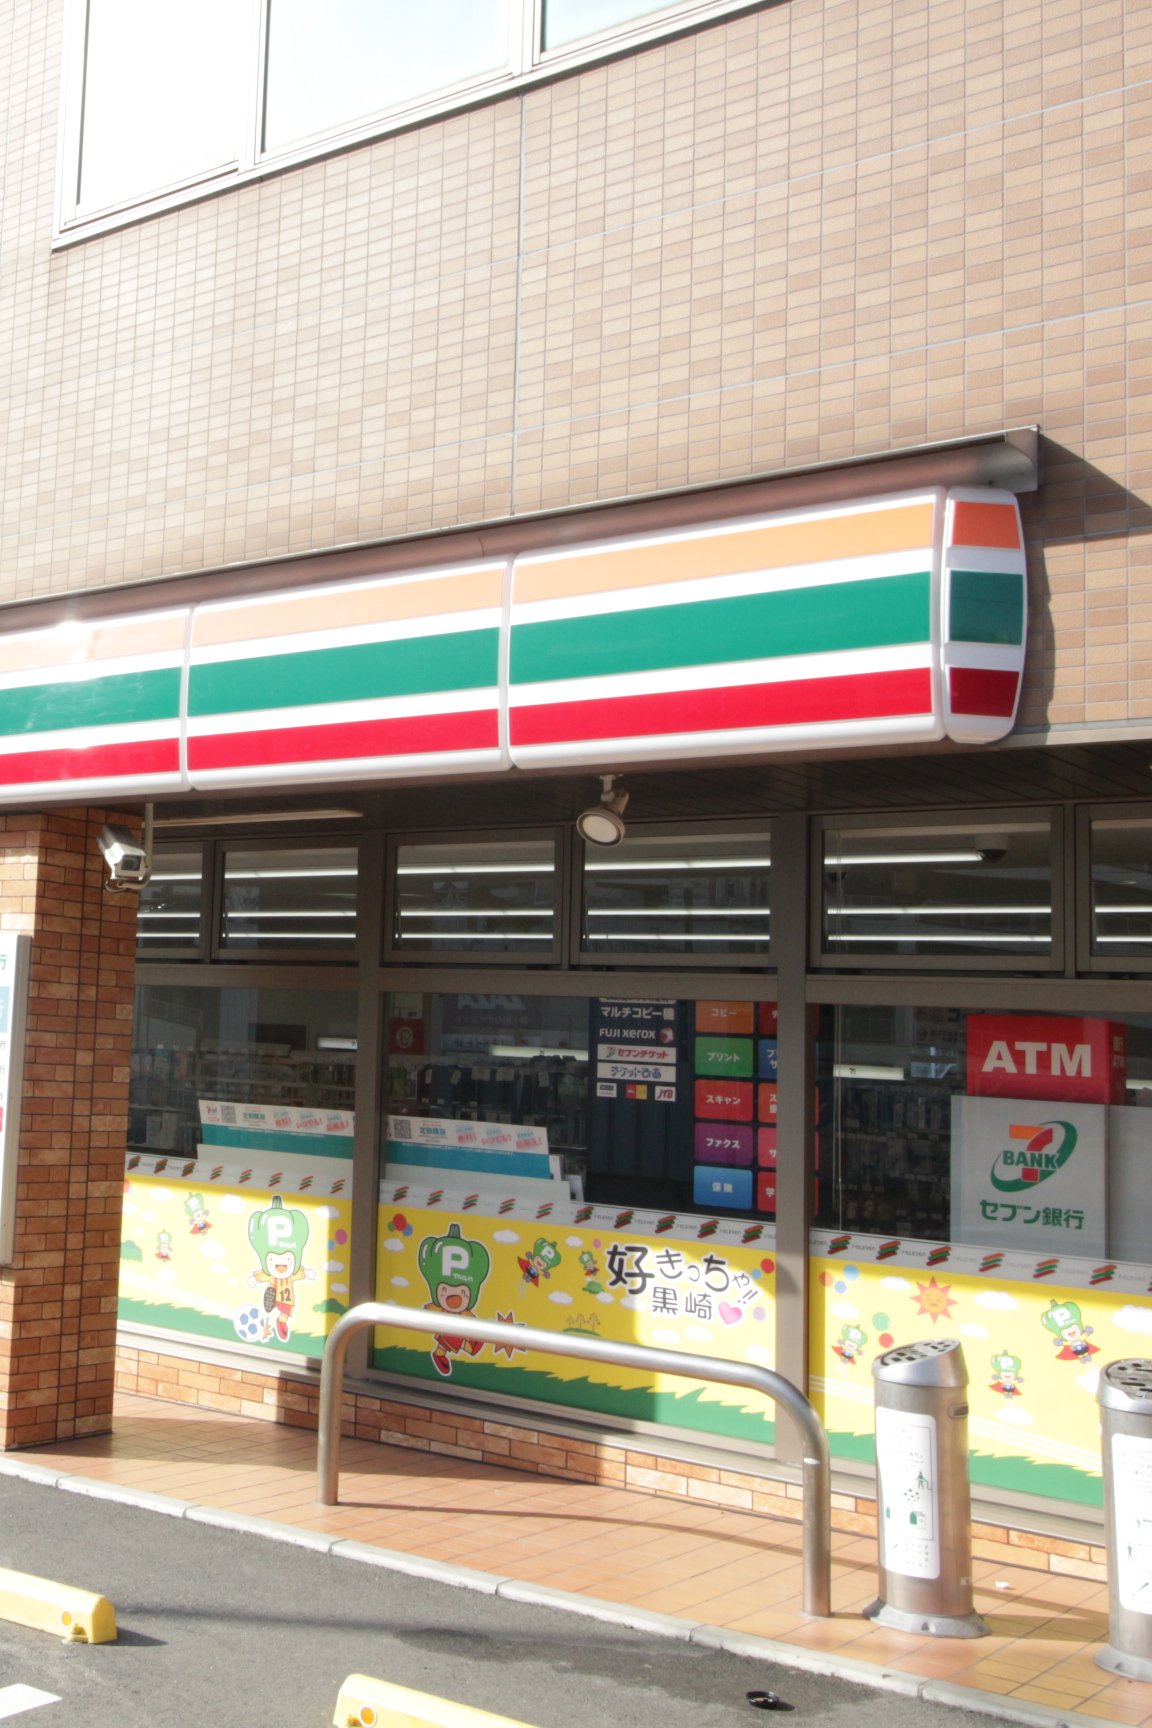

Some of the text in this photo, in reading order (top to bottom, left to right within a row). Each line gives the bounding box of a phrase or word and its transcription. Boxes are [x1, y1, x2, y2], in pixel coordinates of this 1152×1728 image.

[600, 1006, 675, 1020] マルチコピー機
[711, 1008, 737, 1017] コピー
[599, 1028, 621, 1038] FUJI
[617, 1048, 669, 1060] セブンチケット
[707, 1052, 740, 1063] プリント
[981, 1040, 1093, 1077] ATM
[706, 1095, 741, 1105] スキャン
[705, 1138, 741, 1149] ファクス
[1002, 1150, 1059, 1169] BANK
[712, 1182, 733, 1193] 保険
[979, 1199, 1085, 1230] セブン銀行
[267, 1215, 292, 1247] P
[441, 1245, 470, 1278] P
[452, 1272, 474, 1283] man
[279, 1288, 292, 1302] 12
[652, 1287, 713, 1321] 黒崎
